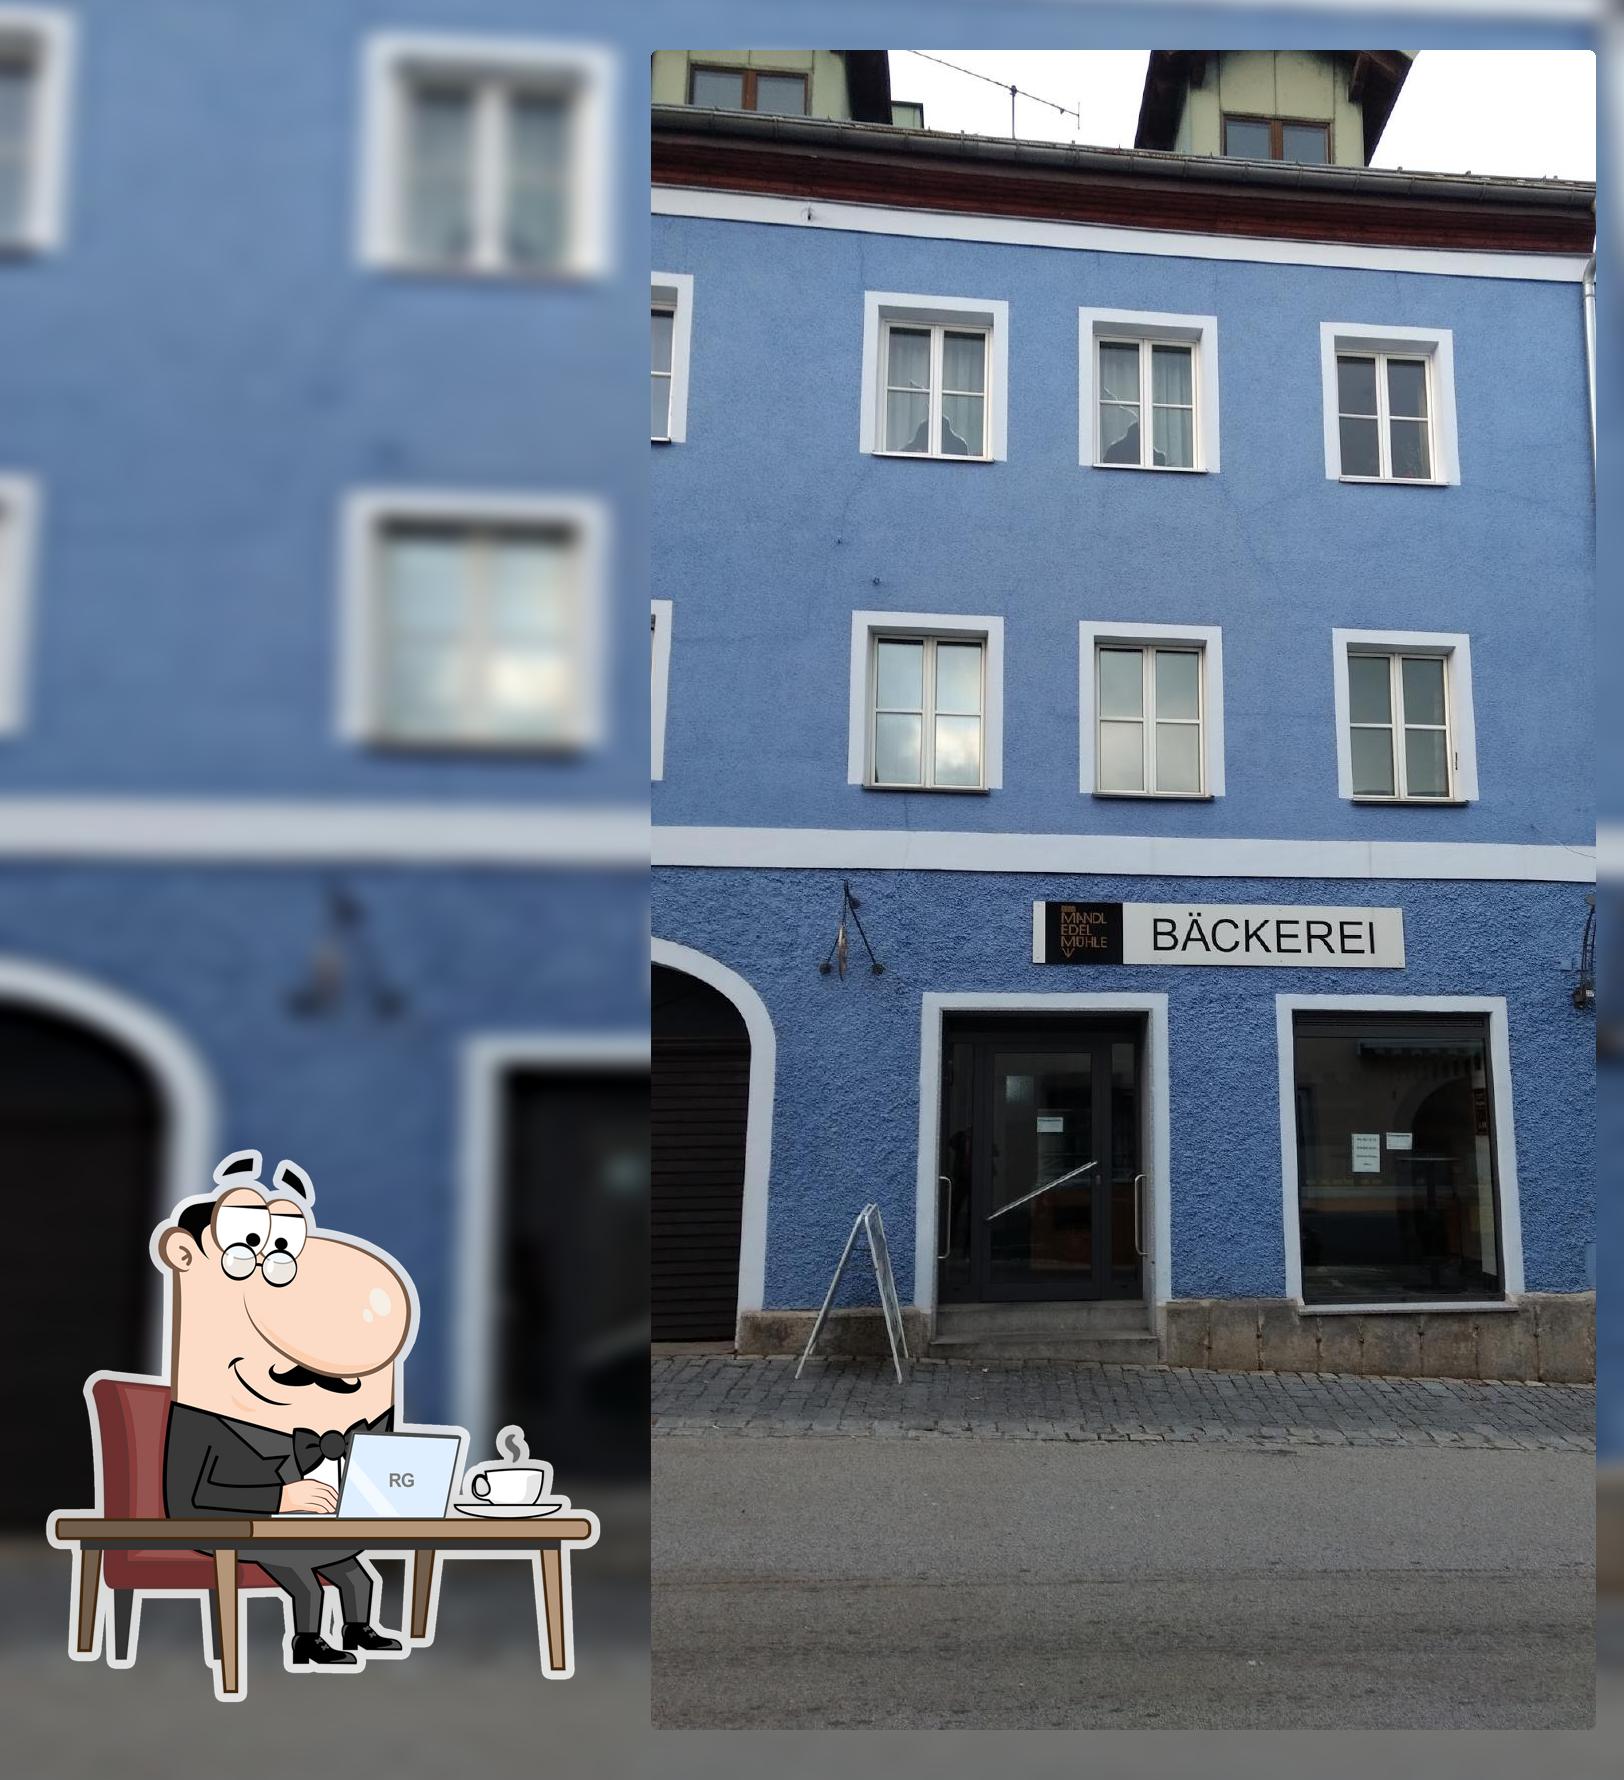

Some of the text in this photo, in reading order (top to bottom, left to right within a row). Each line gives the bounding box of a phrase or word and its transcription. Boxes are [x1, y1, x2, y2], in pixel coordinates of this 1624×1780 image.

[1061, 912, 1108, 924] MANDL
[1061, 924, 1092, 936] EDEL
[1153, 912, 1375, 954] BÄCKEREI
